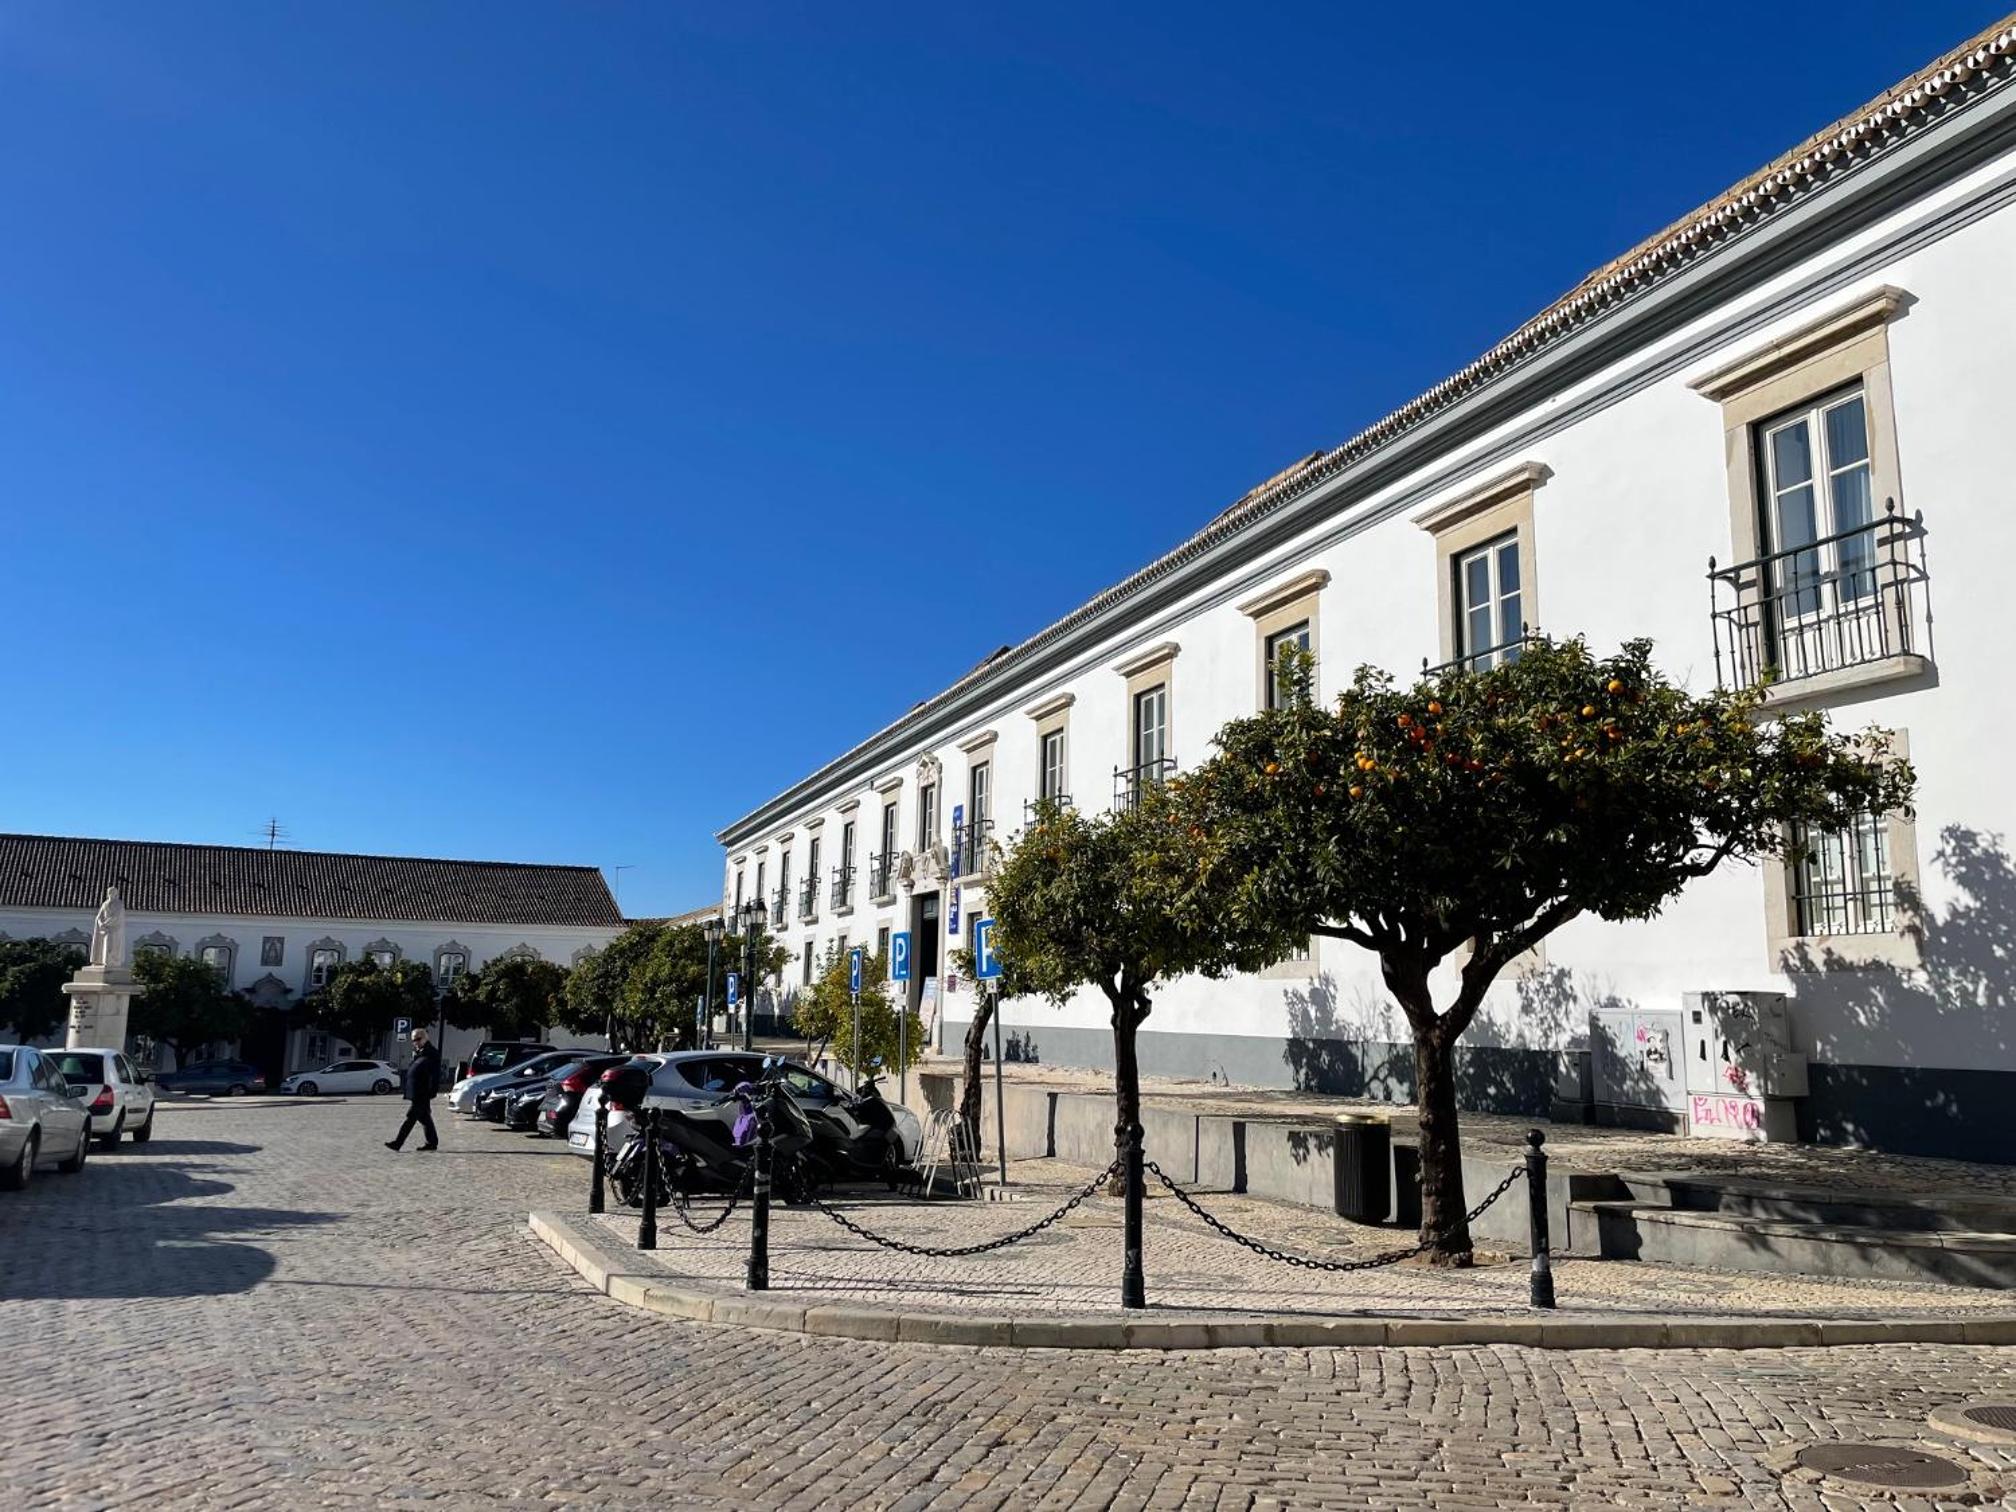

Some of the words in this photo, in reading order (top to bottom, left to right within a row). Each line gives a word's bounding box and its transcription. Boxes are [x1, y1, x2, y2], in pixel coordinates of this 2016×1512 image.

[896, 938, 906, 975] P
[852, 954, 858, 988] P
[729, 977, 735, 1000] P
[398, 1020, 407, 1032] P
